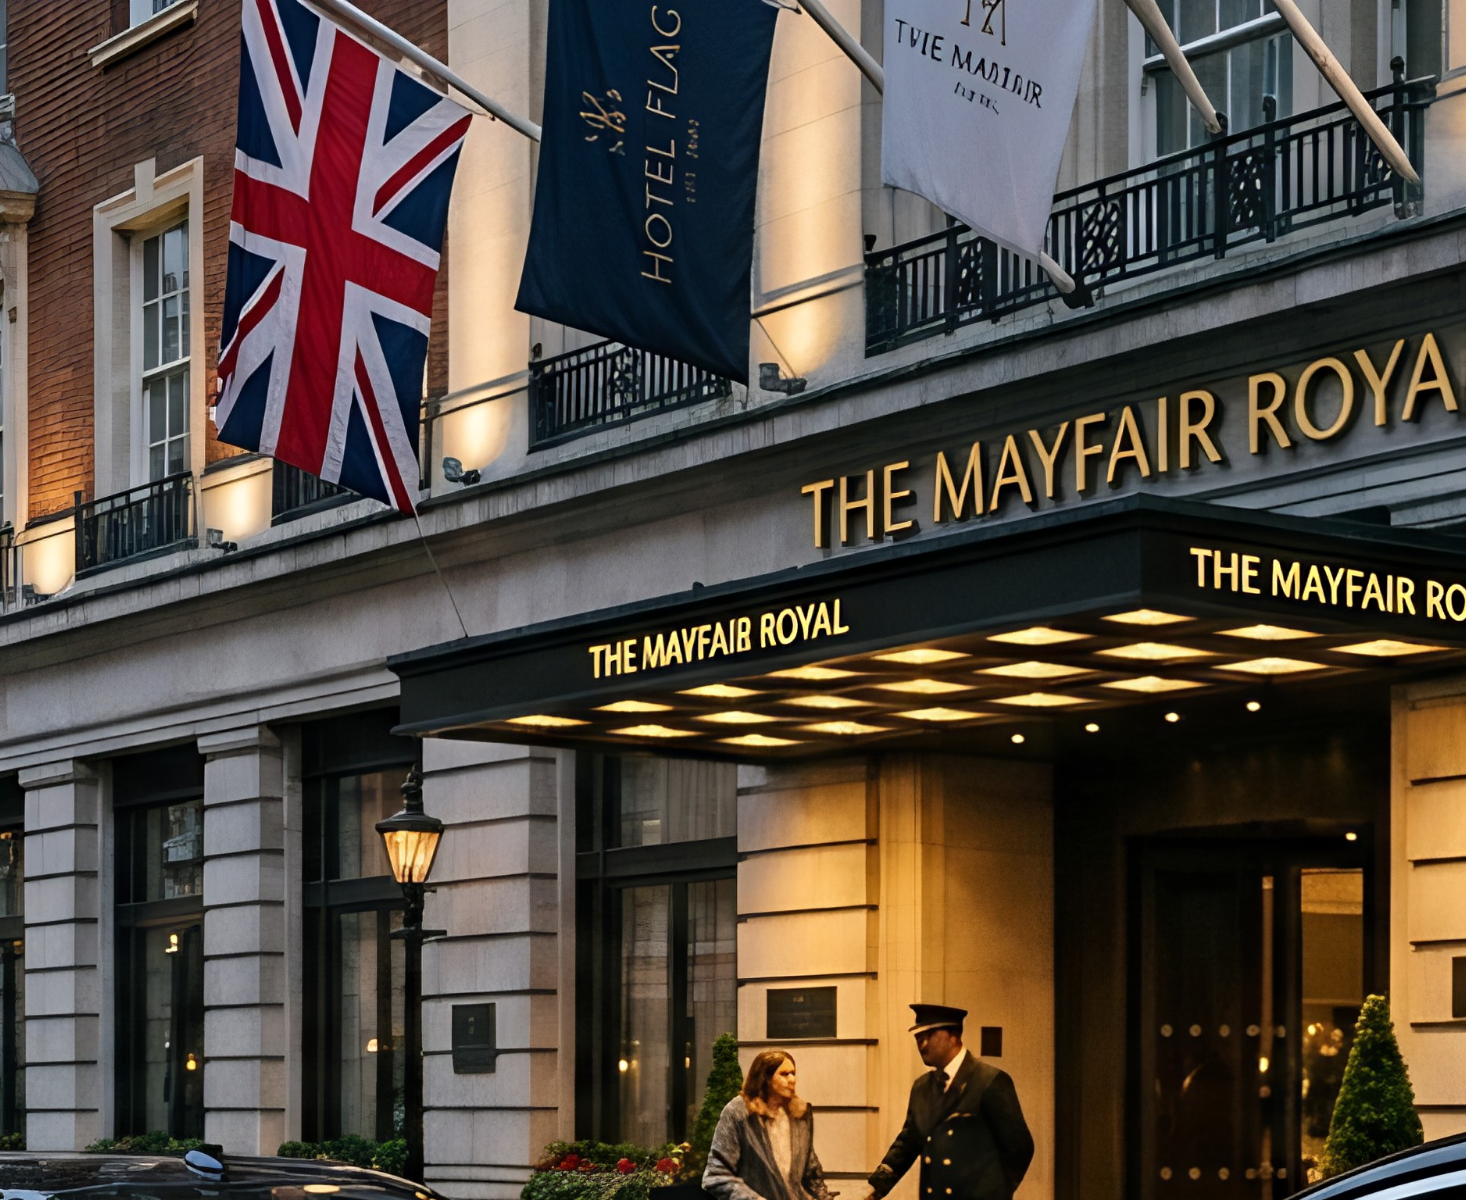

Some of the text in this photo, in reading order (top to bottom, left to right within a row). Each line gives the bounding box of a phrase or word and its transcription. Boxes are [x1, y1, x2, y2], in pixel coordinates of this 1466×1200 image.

[641, 5, 682, 284] HOTEL FLAG
[801, 459, 917, 549] THE
[933, 389, 1222, 525] MAYFAIR
[588, 638, 638, 679] THE
[759, 598, 850, 648] ROYAL
[1189, 546, 1261, 595] THE
[1271, 559, 1416, 615] MAYFAIR
